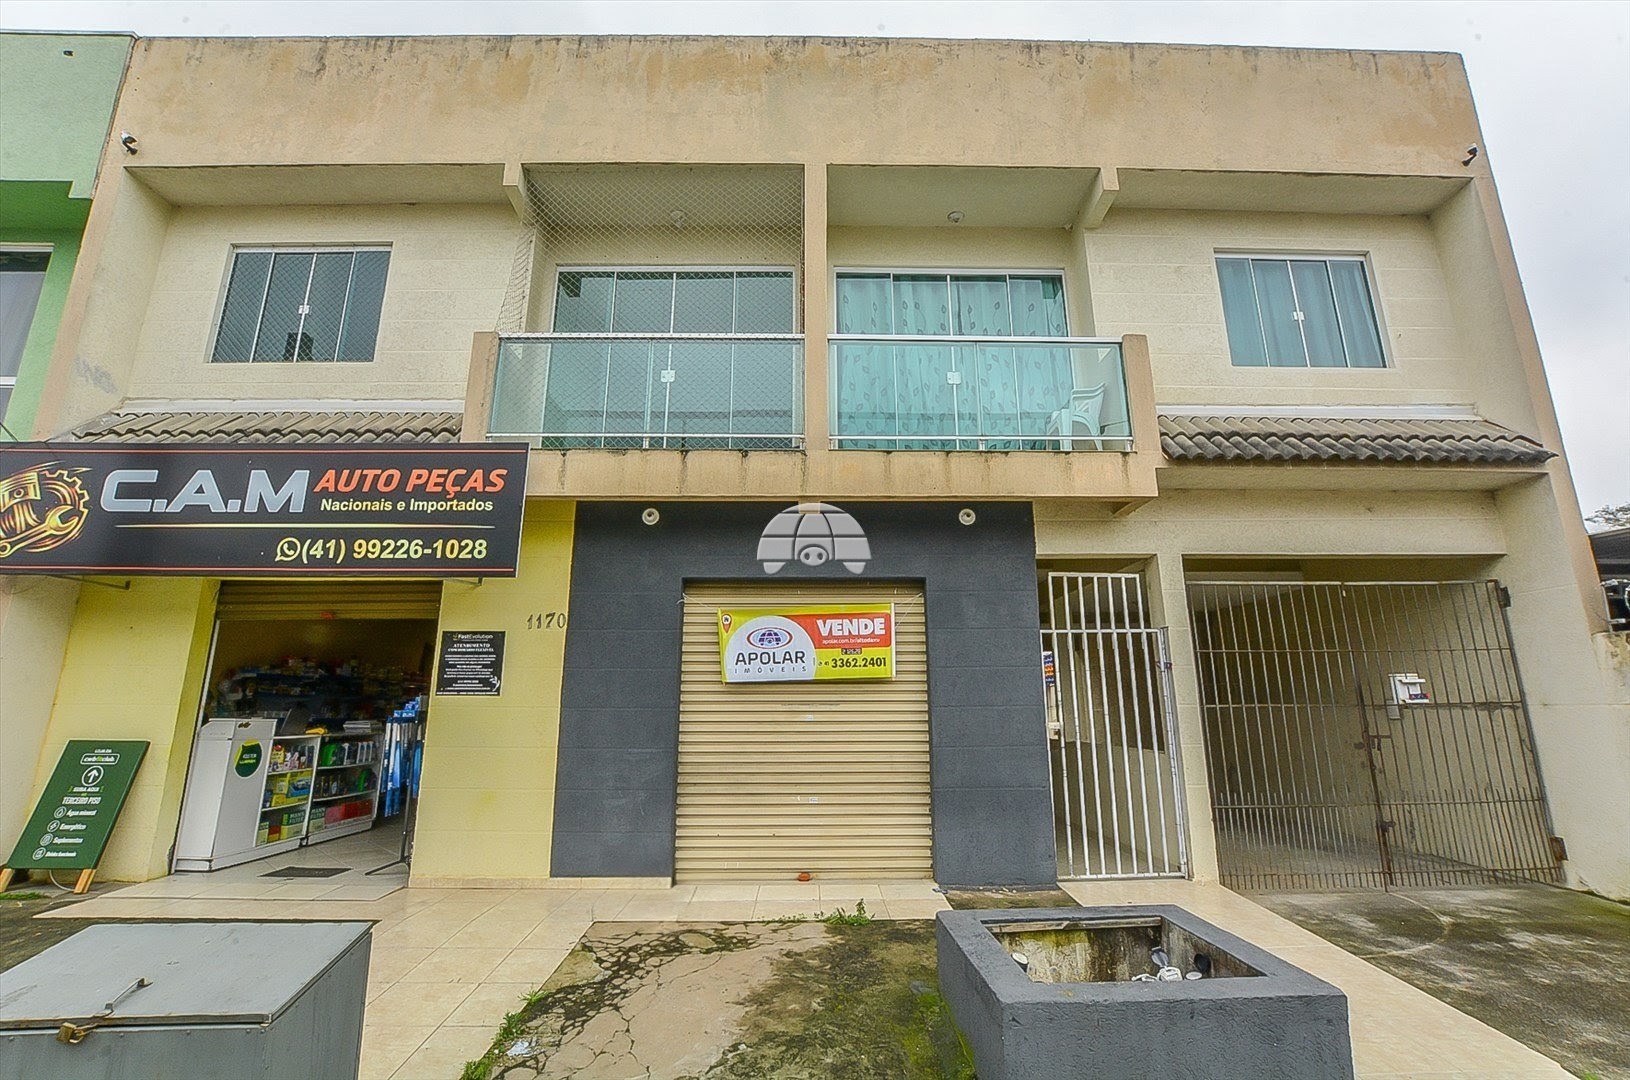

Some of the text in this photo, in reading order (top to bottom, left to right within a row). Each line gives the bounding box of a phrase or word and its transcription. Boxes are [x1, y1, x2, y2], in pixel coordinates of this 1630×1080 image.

[101, 469, 310, 513] C.A.M
[313, 469, 508, 498] AUTO PEÇAS
[320, 498, 494, 513] Nacionais e Importados
[301, 539, 487, 564] (41) 99226-1028
[527, 612, 566, 629] 1170
[816, 617, 886, 636] VENDE
[735, 650, 806, 666] APOLAR
[831, 657, 887, 668] 3362.2401
